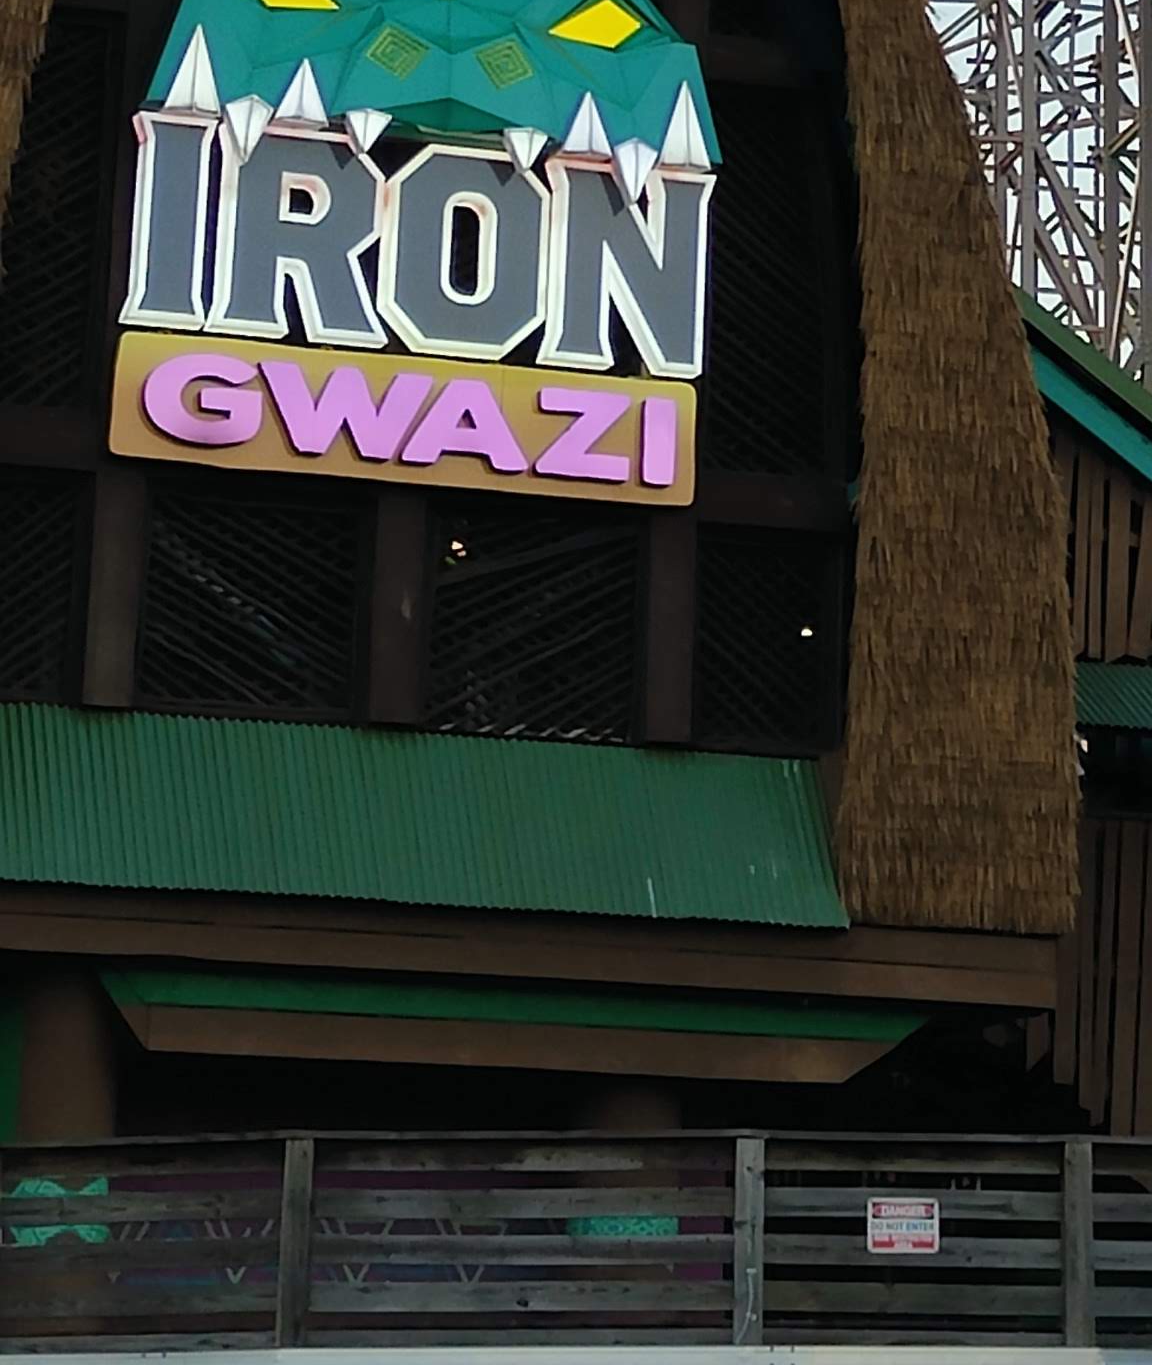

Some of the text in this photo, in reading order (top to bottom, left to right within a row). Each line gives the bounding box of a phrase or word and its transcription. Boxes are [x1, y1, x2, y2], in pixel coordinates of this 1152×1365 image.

[119, 111, 718, 379] IRON
[142, 352, 679, 487] GWAZI
[881, 1204, 925, 1217] DANGER
[885, 1221, 903, 1231] NOT
[906, 1221, 935, 1231] ENTER
